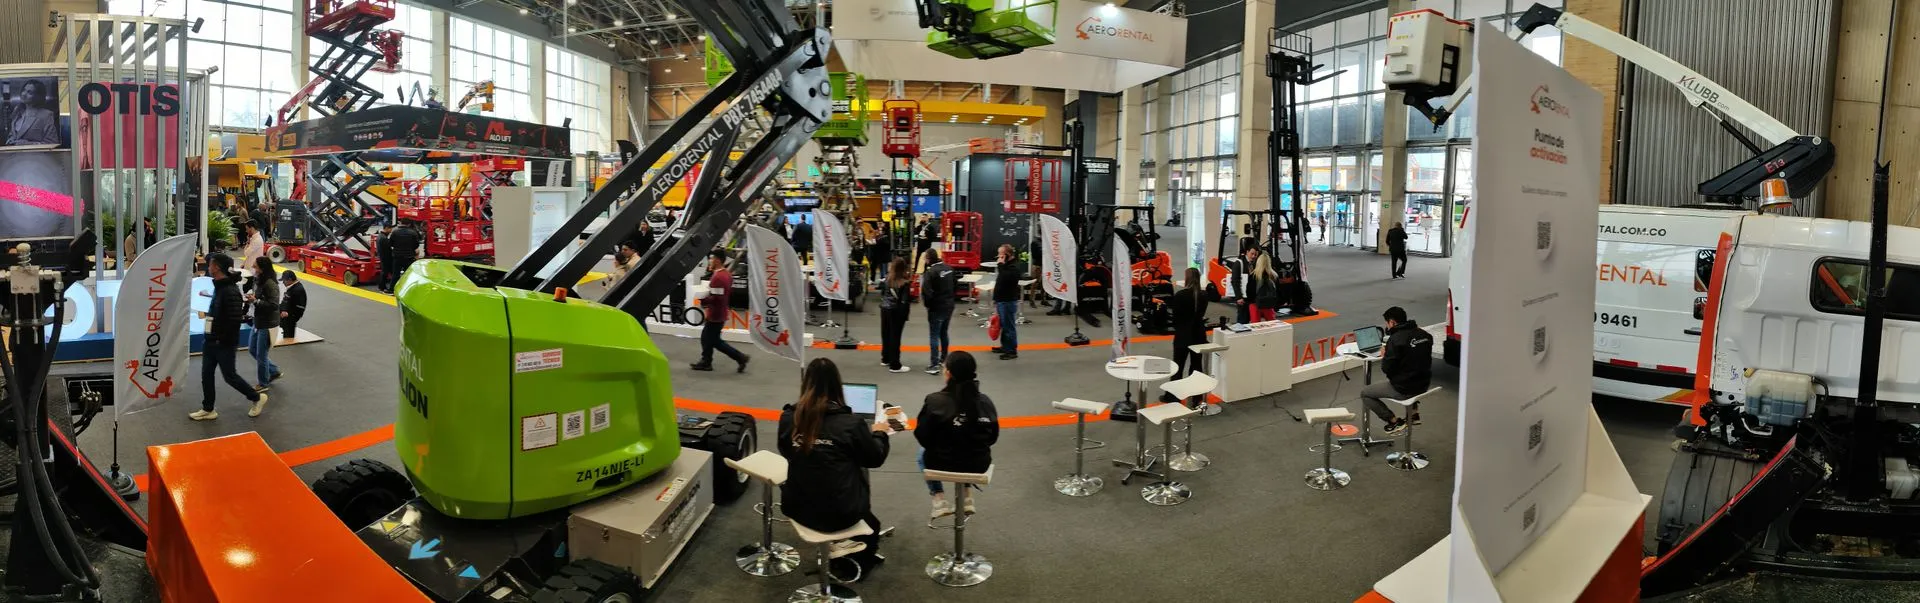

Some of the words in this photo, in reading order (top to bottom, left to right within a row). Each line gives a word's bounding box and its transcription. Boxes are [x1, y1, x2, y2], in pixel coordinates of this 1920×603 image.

[1087, 25, 1155, 42] AERORENTAL
[78, 82, 180, 117] OTIS
[651, 127, 723, 201] AERORENTAL
[722, 103, 749, 130] PBX:
[1764, 158, 1786, 173] E13
[765, 247, 779, 333] AERORENTAL
[143, 263, 168, 382] AERORENTAL
